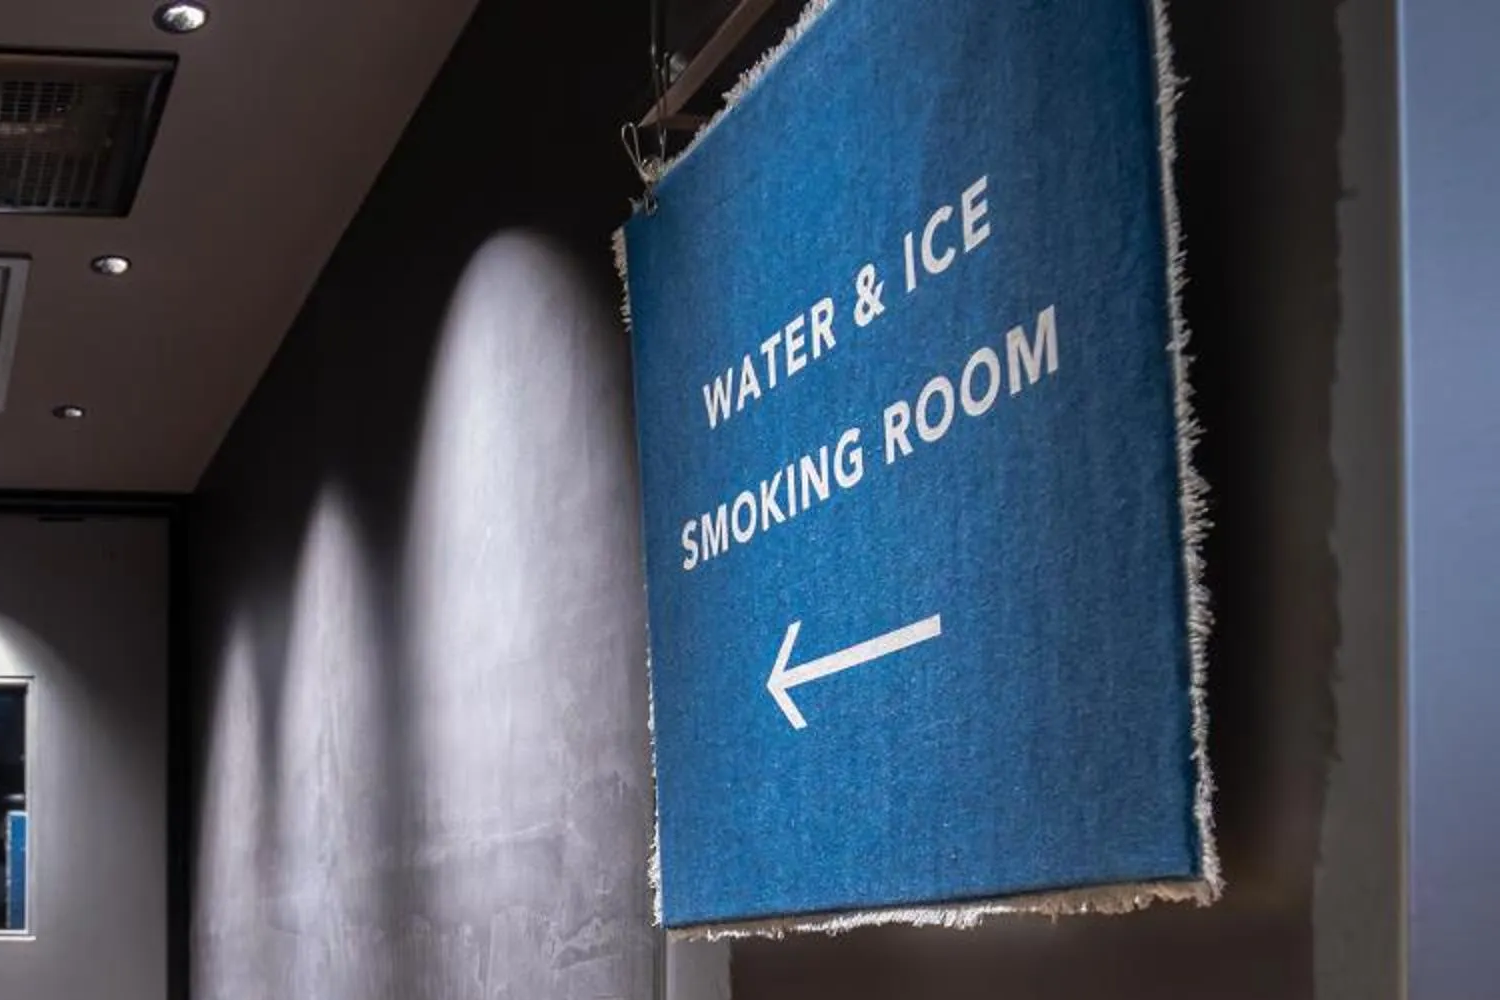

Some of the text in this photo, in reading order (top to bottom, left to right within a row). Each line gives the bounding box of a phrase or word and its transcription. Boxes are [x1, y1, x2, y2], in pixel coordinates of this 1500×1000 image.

[702, 175, 993, 430] WATER & ICE
[681, 304, 1060, 571] SMOKING ROOM
